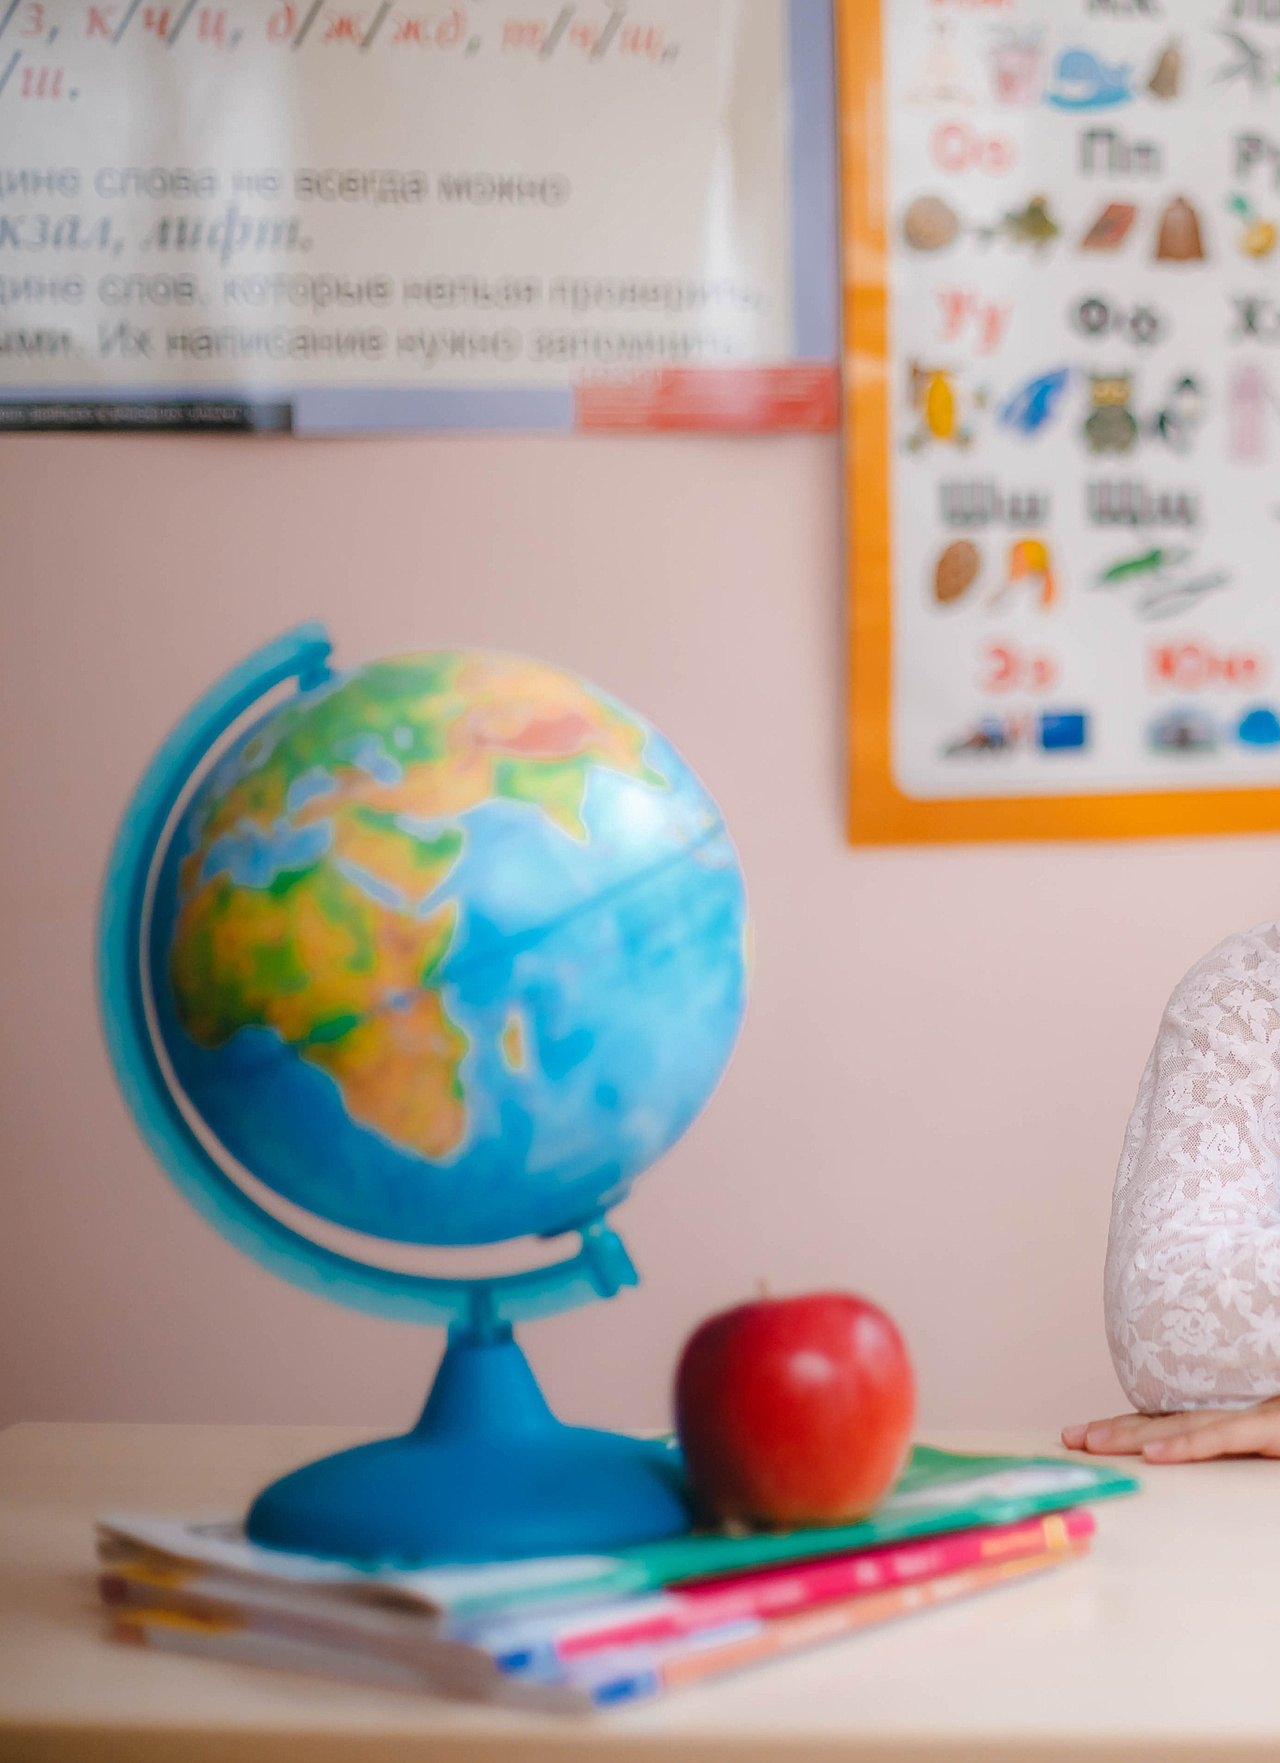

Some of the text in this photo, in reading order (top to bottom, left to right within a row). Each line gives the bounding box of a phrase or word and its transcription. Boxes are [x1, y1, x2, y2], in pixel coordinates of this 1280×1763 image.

[1078, 126, 1161, 175] Пп
[95, 167, 218, 198] слова
[231, 168, 281, 199] не
[296, 168, 430, 203] всегда
[440, 171, 571, 206] можно
[224, 273, 395, 313] которые
[403, 275, 544, 309] нельзя
[165, 325, 389, 361] написание
[397, 326, 523, 368] нужно
